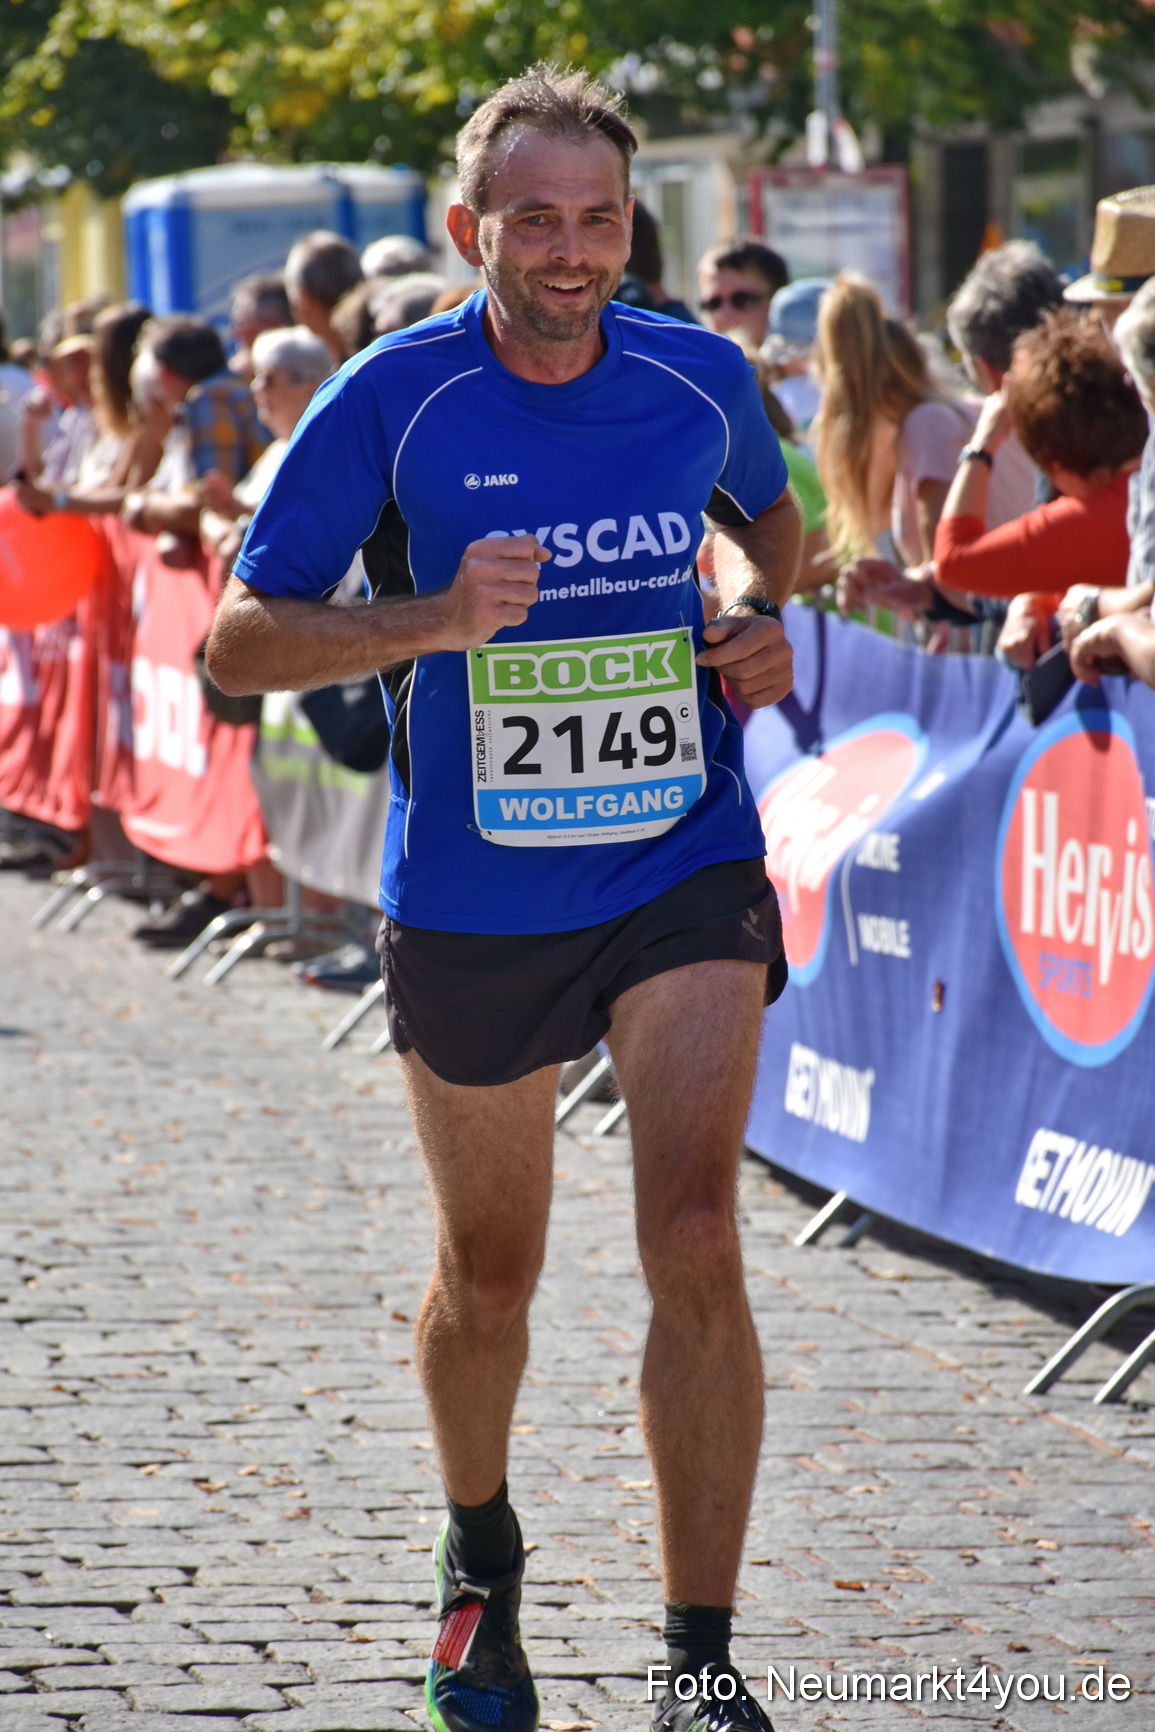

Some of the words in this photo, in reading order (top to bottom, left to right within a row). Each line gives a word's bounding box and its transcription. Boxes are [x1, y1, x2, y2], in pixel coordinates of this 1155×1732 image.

[483, 473, 519, 487] JAKO
[484, 511, 691, 571] YSCAD
[489, 641, 677, 694] BOCK
[680, 706, 690, 718] C
[502, 705, 677, 775] 2149
[499, 785, 684, 822] WOLFGANG
[1020, 787, 1155, 987] Hervis
[1037, 952, 1093, 999] SPORTS
